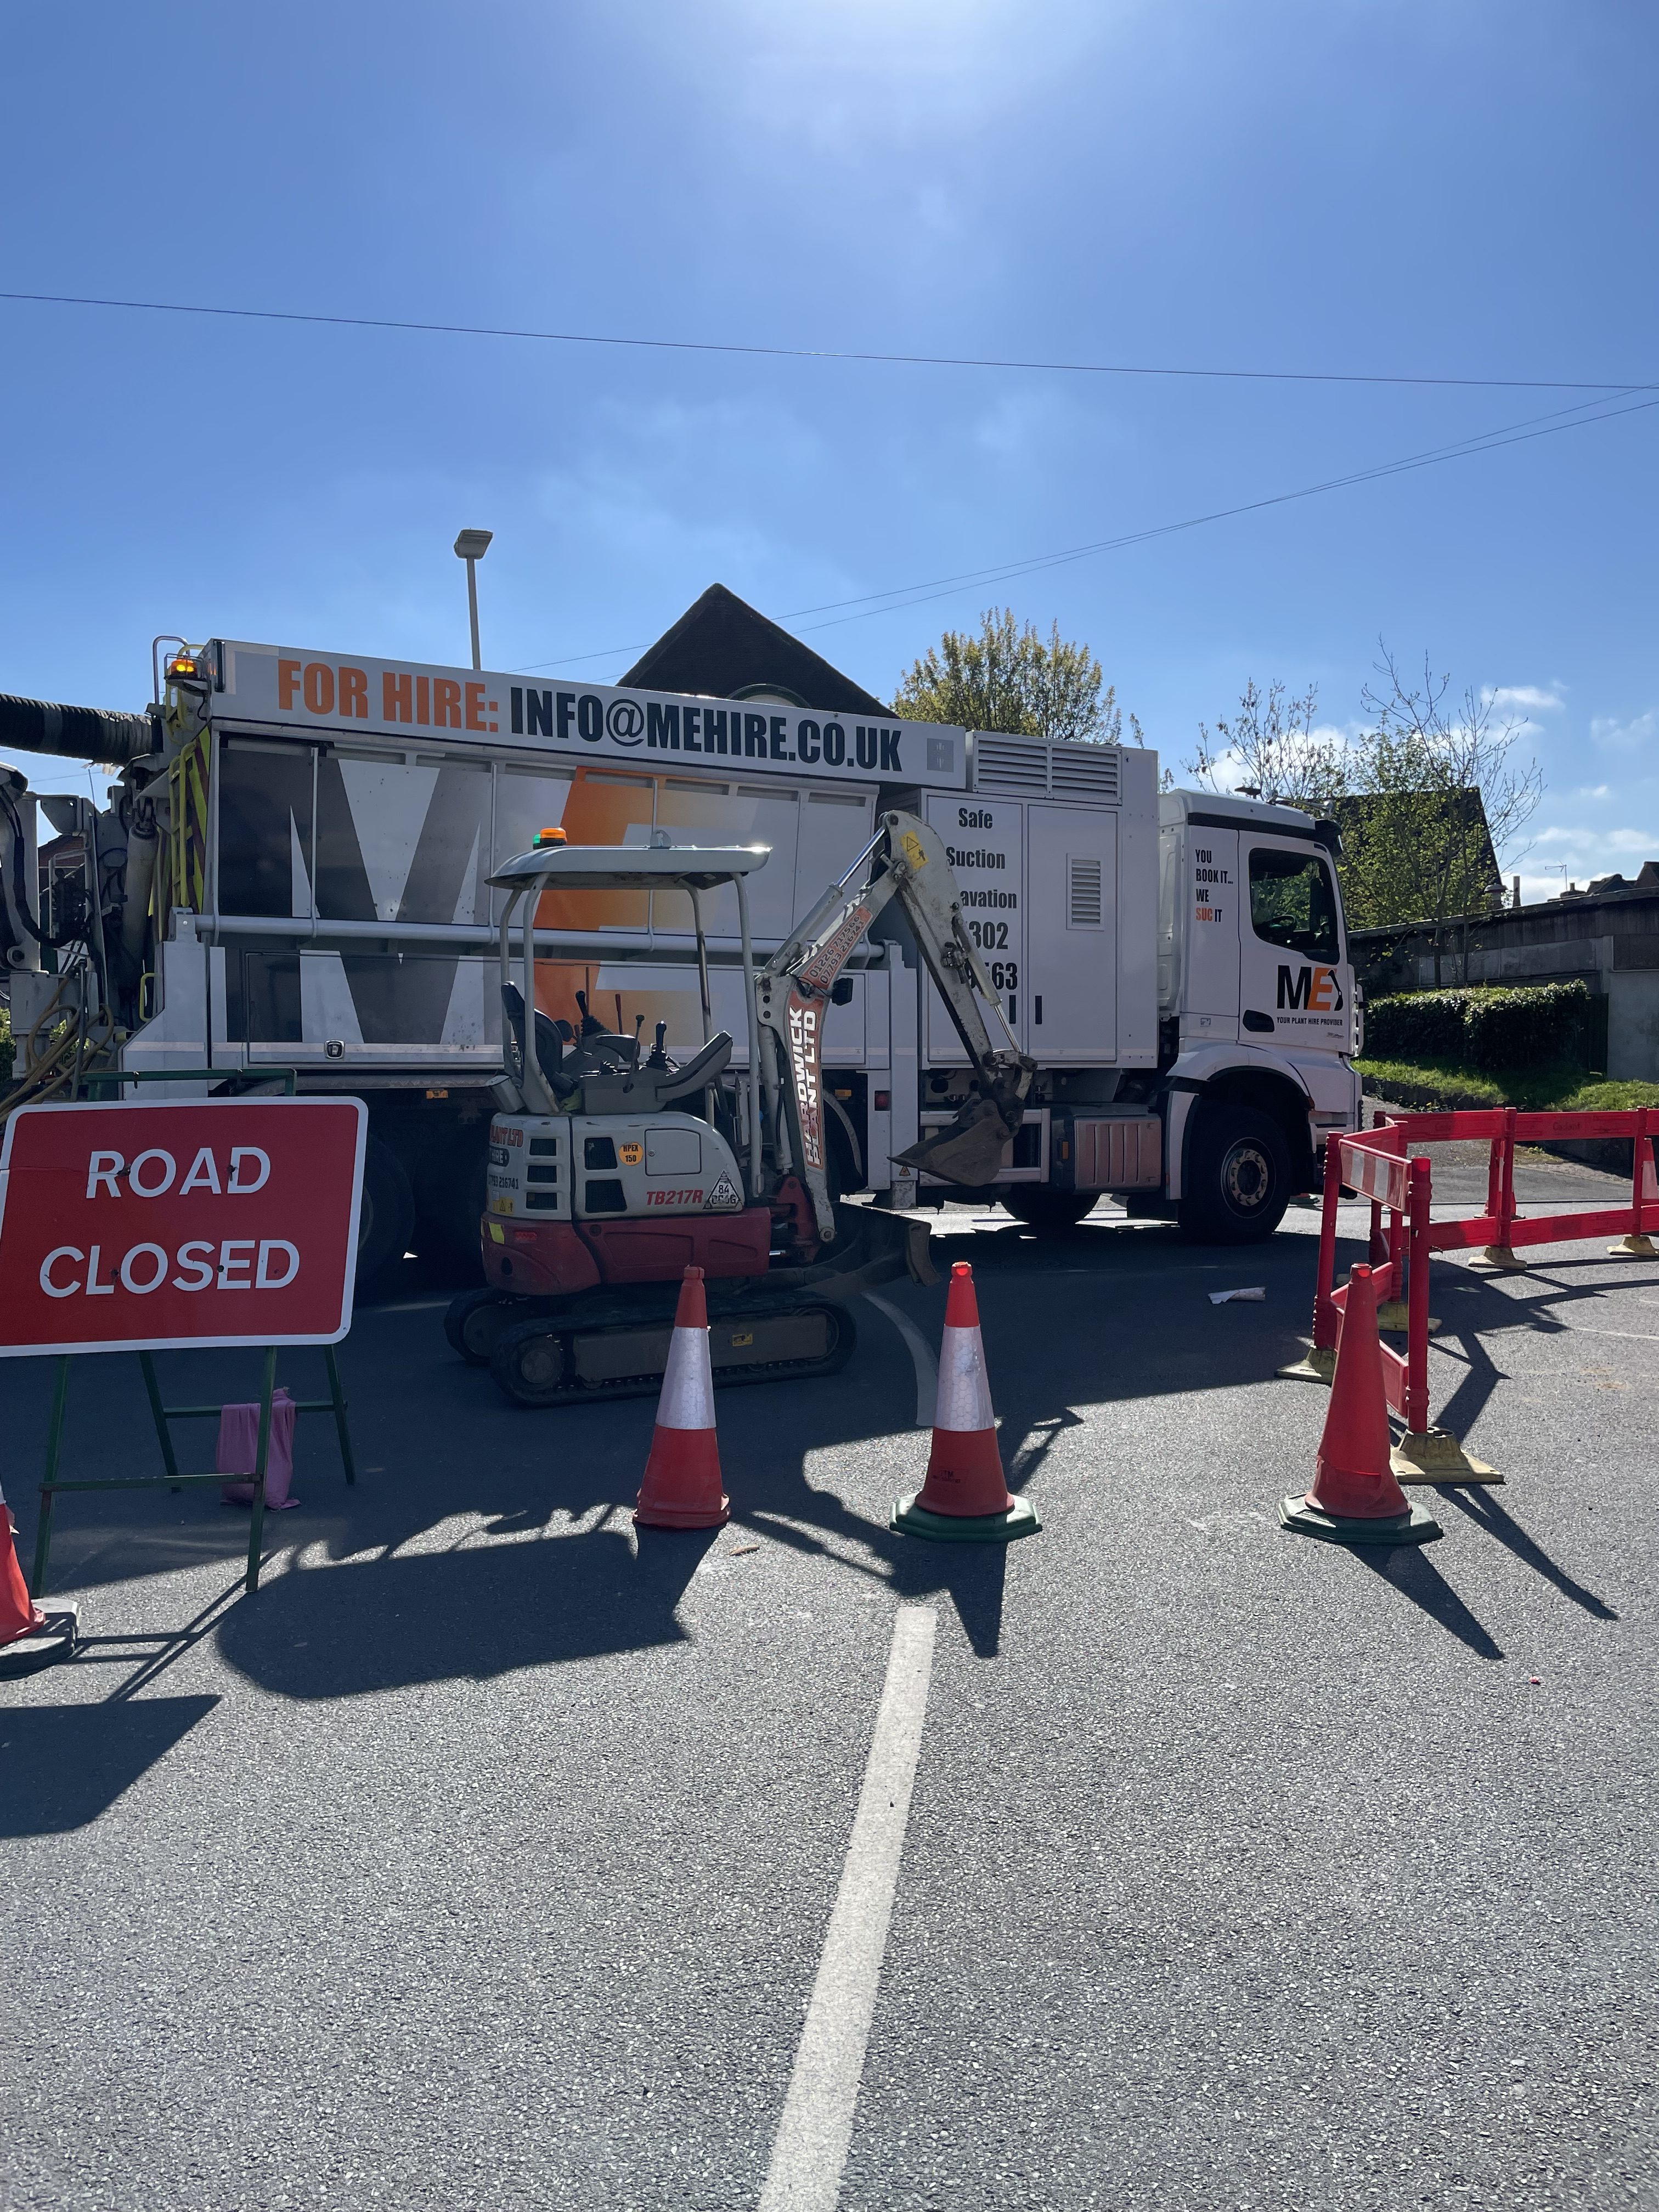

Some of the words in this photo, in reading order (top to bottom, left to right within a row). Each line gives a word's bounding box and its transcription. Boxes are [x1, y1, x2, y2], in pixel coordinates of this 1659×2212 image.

[278, 659, 369, 719] FOR
[382, 672, 499, 732] HIRE:
[510, 686, 902, 772] INFO@MEHIRE.CO.UK
[958, 808, 993, 830] Safe
[946, 847, 1006, 870] Suction
[1195, 849, 1212, 864] YOU
[1195, 868, 1219, 883] BOOK
[961, 889, 1018, 910] avation
[1195, 888, 1210, 903] WE
[1195, 907, 1213, 922] SUC
[1214, 909, 1223, 923] IT
[968, 921, 1009, 950] 302
[809, 949, 834, 978] 01226
[832, 915, 860, 949] 717566
[820, 952, 843, 985] 07793
[839, 919, 865, 952] 216741
[1277, 1016, 1290, 1024] YOUR
[1321, 1018, 1343, 1026] PROVIDER
[803, 1010, 816, 1064] LTD
[789, 1006, 814, 1163] HARDWICK
[805, 1068, 821, 1165] PLANT
[507, 1128, 523, 1148] LTD
[623, 1144, 639, 1153] HPEX
[625, 1155, 637, 1163] 150
[86, 1146, 271, 1199] ROAD
[499, 1176, 519, 1190] 216741
[646, 1189, 704, 1206] TB217R
[718, 1184, 729, 1194] 84
[39, 1239, 301, 1299] CLOSED
